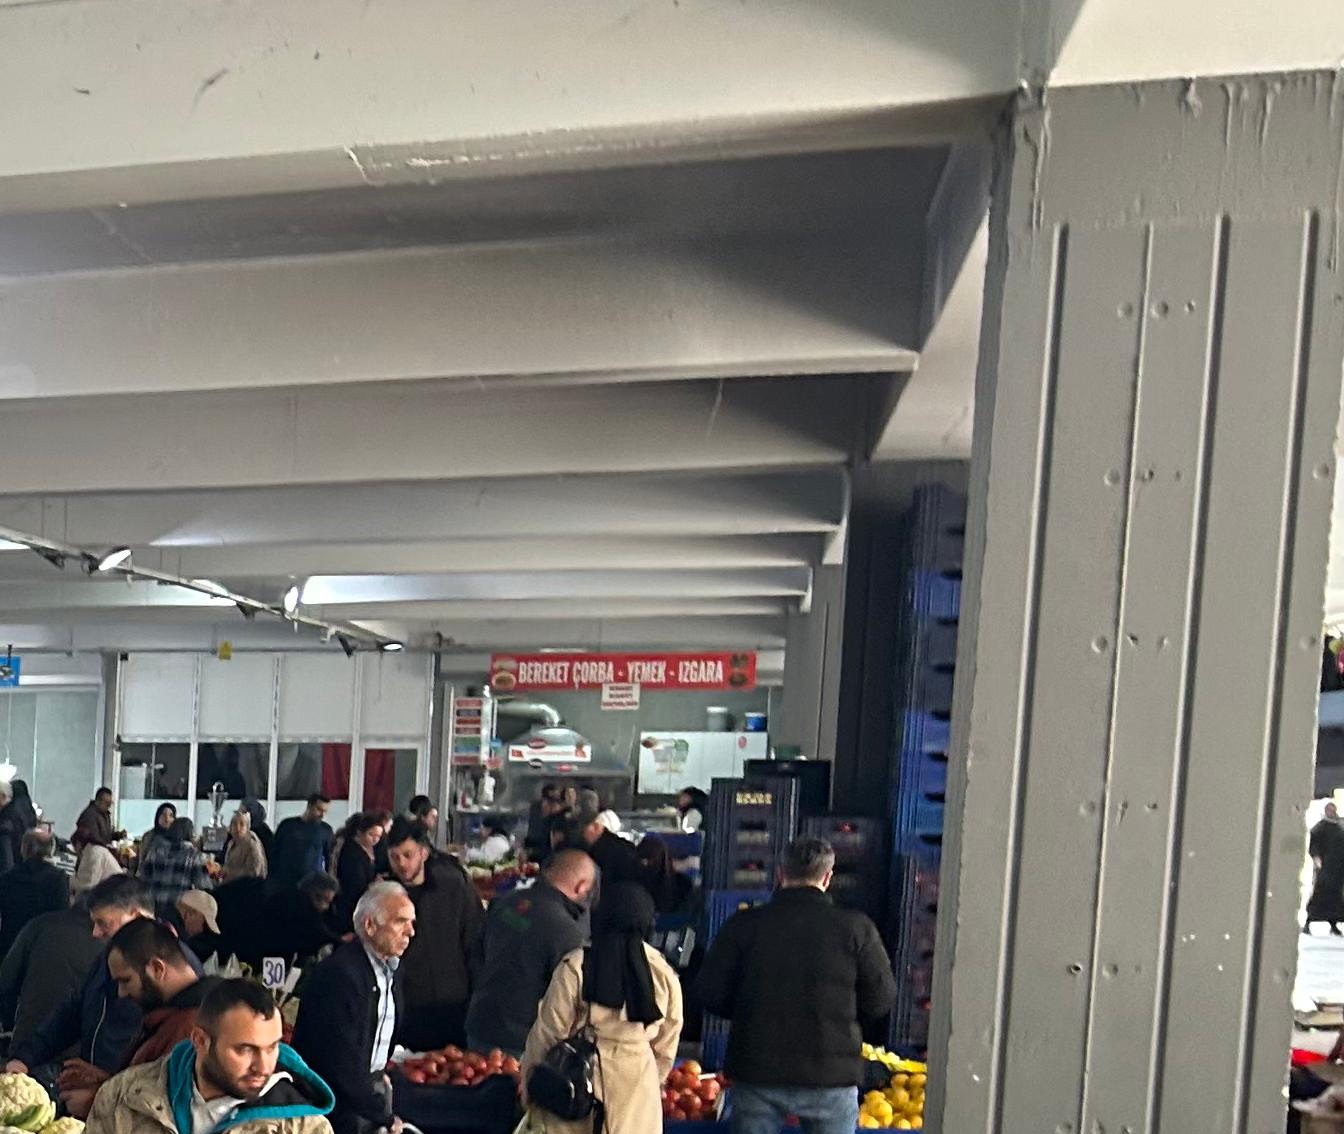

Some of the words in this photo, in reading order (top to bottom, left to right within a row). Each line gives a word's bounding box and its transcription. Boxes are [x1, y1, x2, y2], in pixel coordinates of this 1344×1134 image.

[518, 661, 570, 684] BEREKET
[572, 660, 614, 689] ÇORBA
[627, 660, 667, 684] YEMEK
[678, 660, 723, 684] IZGARA
[264, 960, 282, 986] 30
